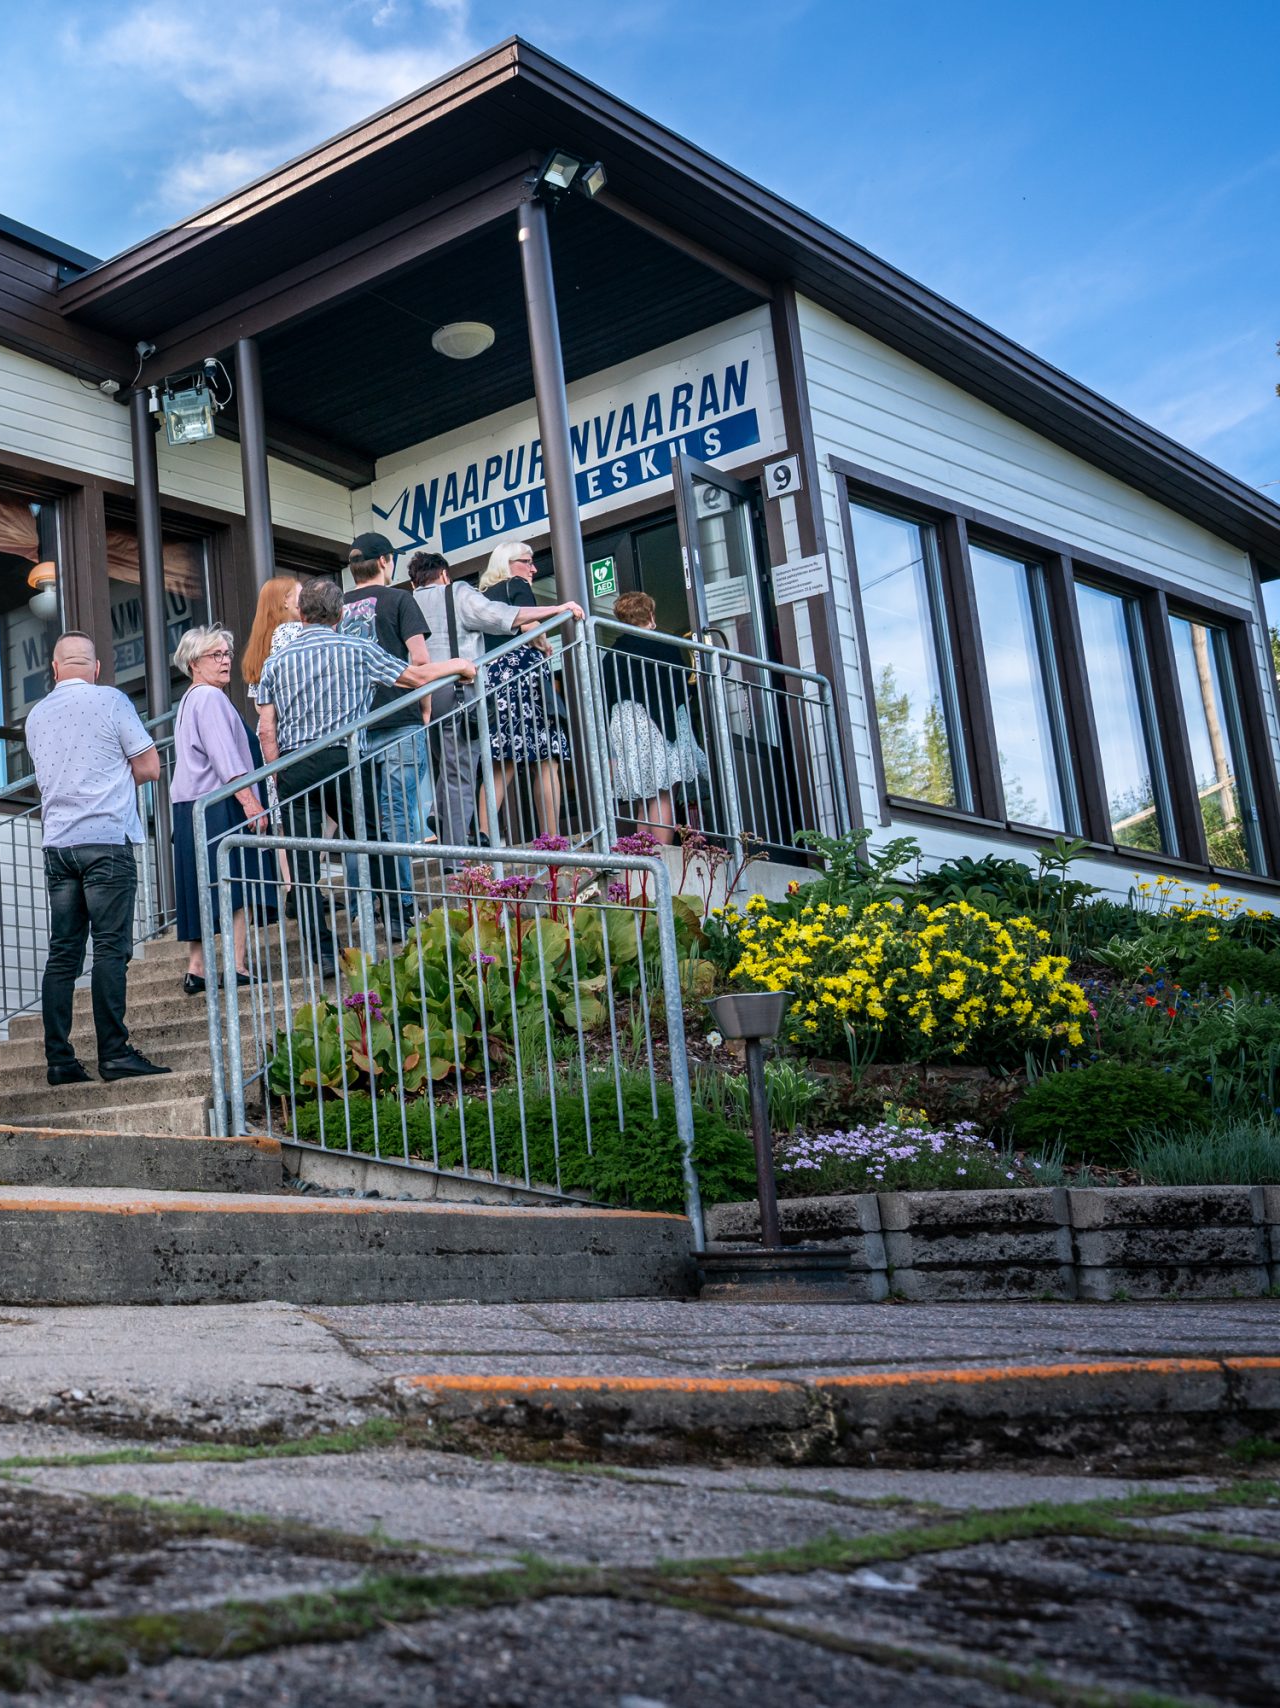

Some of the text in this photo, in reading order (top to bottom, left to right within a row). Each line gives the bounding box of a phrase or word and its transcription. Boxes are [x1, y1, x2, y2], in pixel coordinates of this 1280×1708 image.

[411, 359, 749, 539] NAAPURNVAARAN
[466, 427, 722, 542] HUVIESKS
[773, 464, 792, 491] 9
[596, 581, 613, 592] AED
